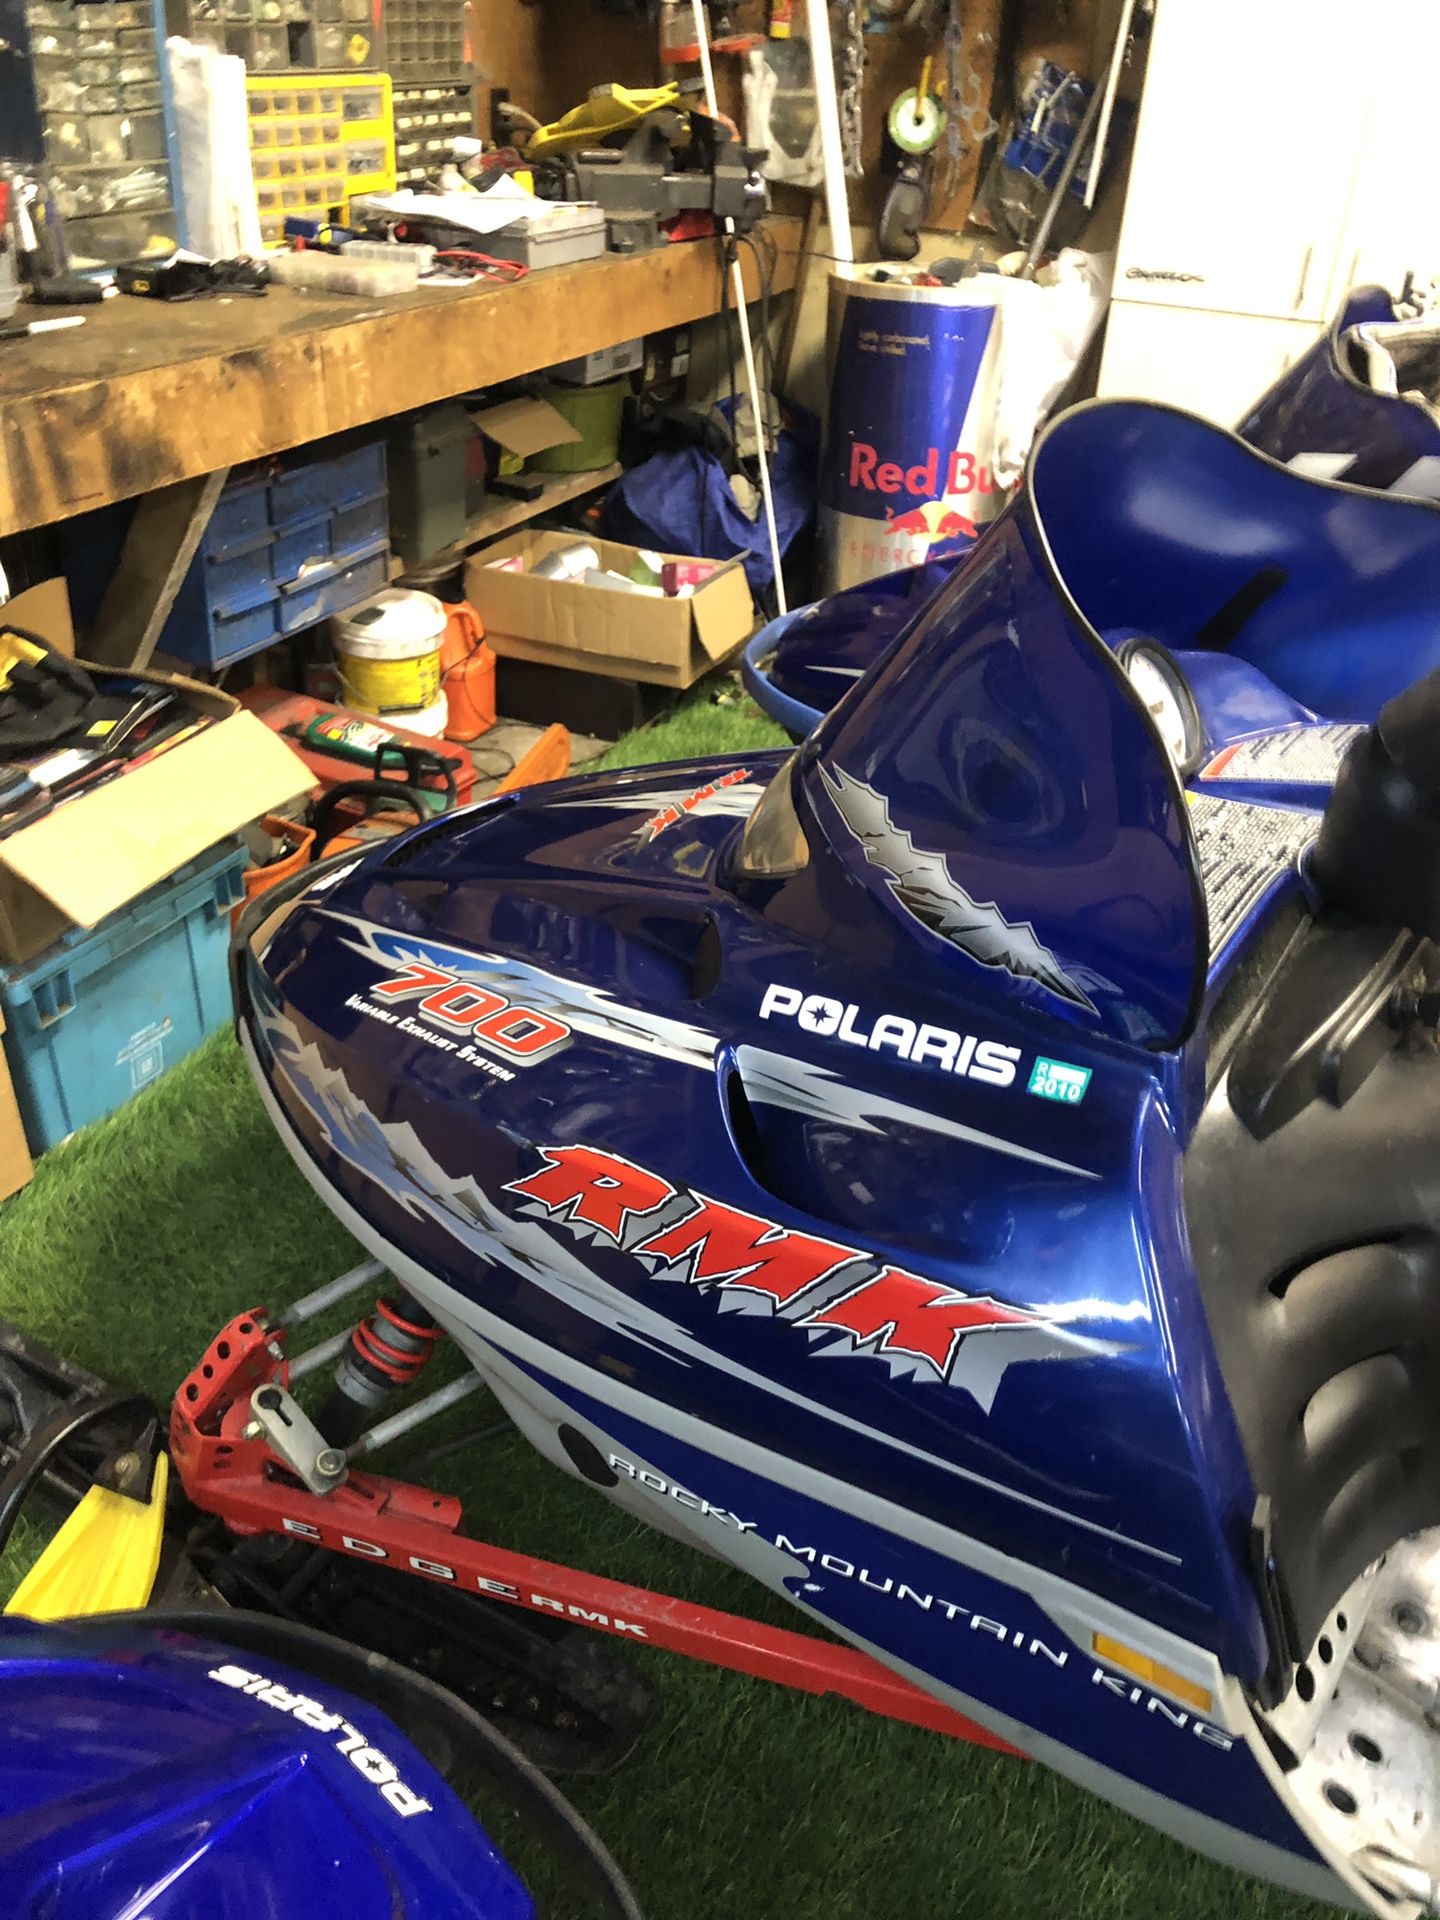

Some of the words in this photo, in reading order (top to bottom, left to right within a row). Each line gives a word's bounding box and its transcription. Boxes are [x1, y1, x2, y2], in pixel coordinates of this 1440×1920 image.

[850, 441, 940, 496] Red
[946, 450, 995, 496] Bu
[369, 961, 574, 1062] 700
[758, 983, 1022, 1088] POLARIS
[1031, 1075, 1081, 1104] 2010
[501, 1144, 1068, 1390] RMK
[608, 1453, 758, 1533] ROCKY
[775, 1533, 1069, 1669] MOUNTAIN
[1092, 1667, 1235, 1752] KING
[207, 1664, 433, 1818] POLARIS
